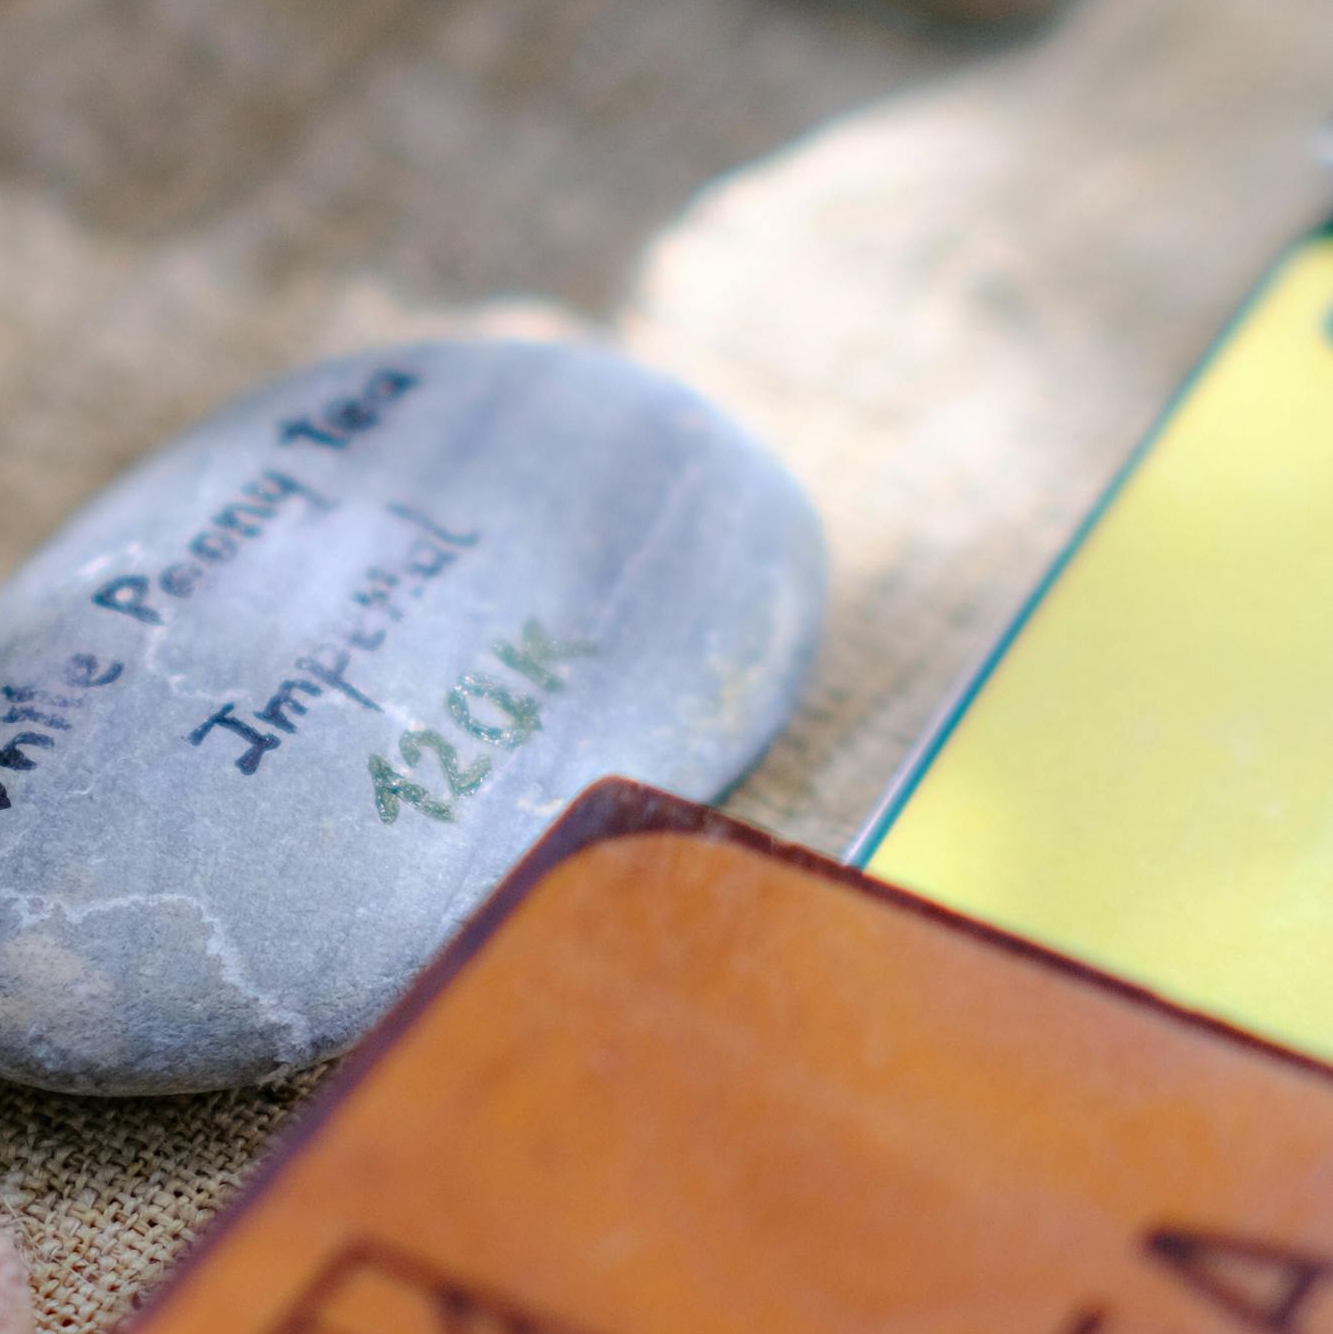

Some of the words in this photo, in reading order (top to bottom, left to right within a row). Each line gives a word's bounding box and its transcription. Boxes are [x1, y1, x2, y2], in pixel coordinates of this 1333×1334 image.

[91, 469, 338, 627] Peony
[276, 367, 422, 451] tea
[366, 617, 600, 826] 120K
